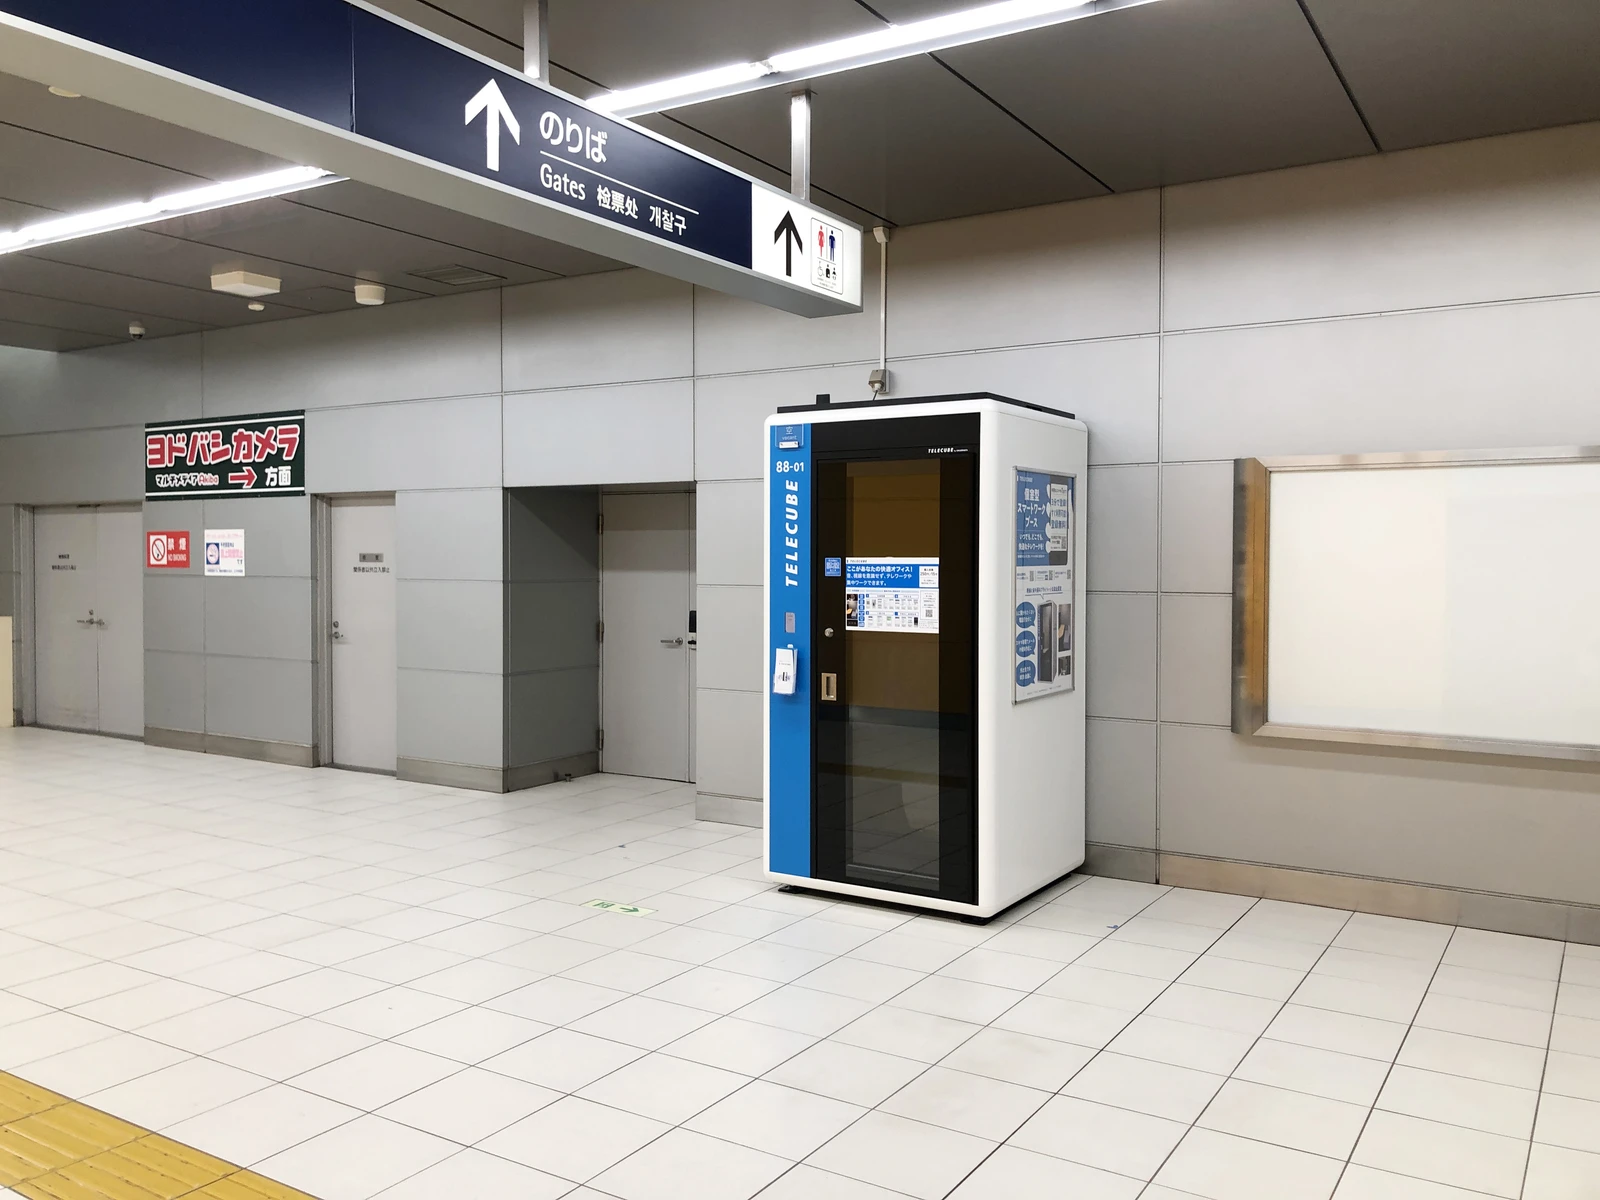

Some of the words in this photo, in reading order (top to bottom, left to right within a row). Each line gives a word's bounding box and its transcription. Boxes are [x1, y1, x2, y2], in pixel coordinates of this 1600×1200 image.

[539, 111, 608, 164] のりば
[540, 163, 586, 201] Gates
[596, 183, 639, 220] 检票处
[649, 204, 687, 236] 개찰구
[146, 424, 300, 468] ヨドバシカメラ
[264, 466, 292, 487] 方面
[776, 460, 805, 473] 88-01
[1017, 502, 1046, 515] スマートワーク
[1025, 516, 1038, 527] ブース
[785, 479, 799, 587] TELECUBE
